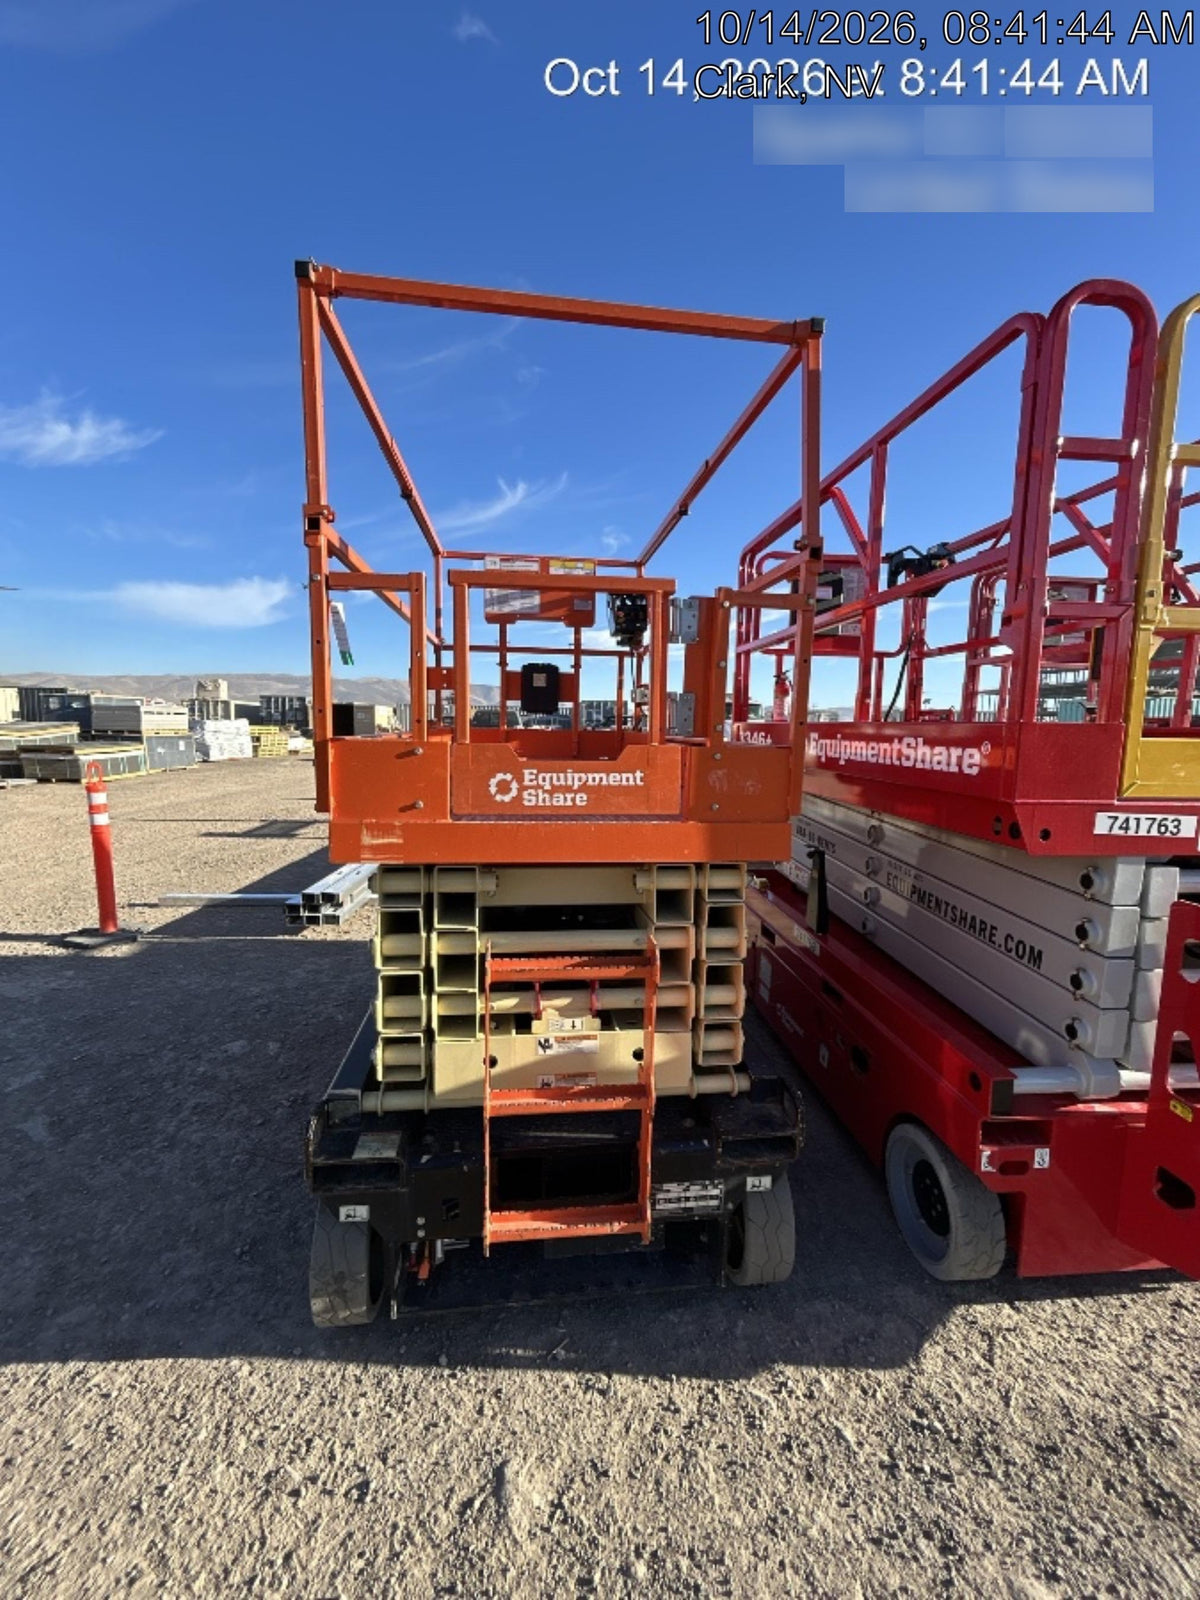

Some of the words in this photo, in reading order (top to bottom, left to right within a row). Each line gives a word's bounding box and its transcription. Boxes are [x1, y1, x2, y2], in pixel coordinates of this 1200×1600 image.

[522, 768, 645, 790] Equipment
[522, 788, 588, 806] Share
[1107, 815, 1182, 836] 741763
[886, 871, 1043, 971] EQUIPMENTSHARE.COM
